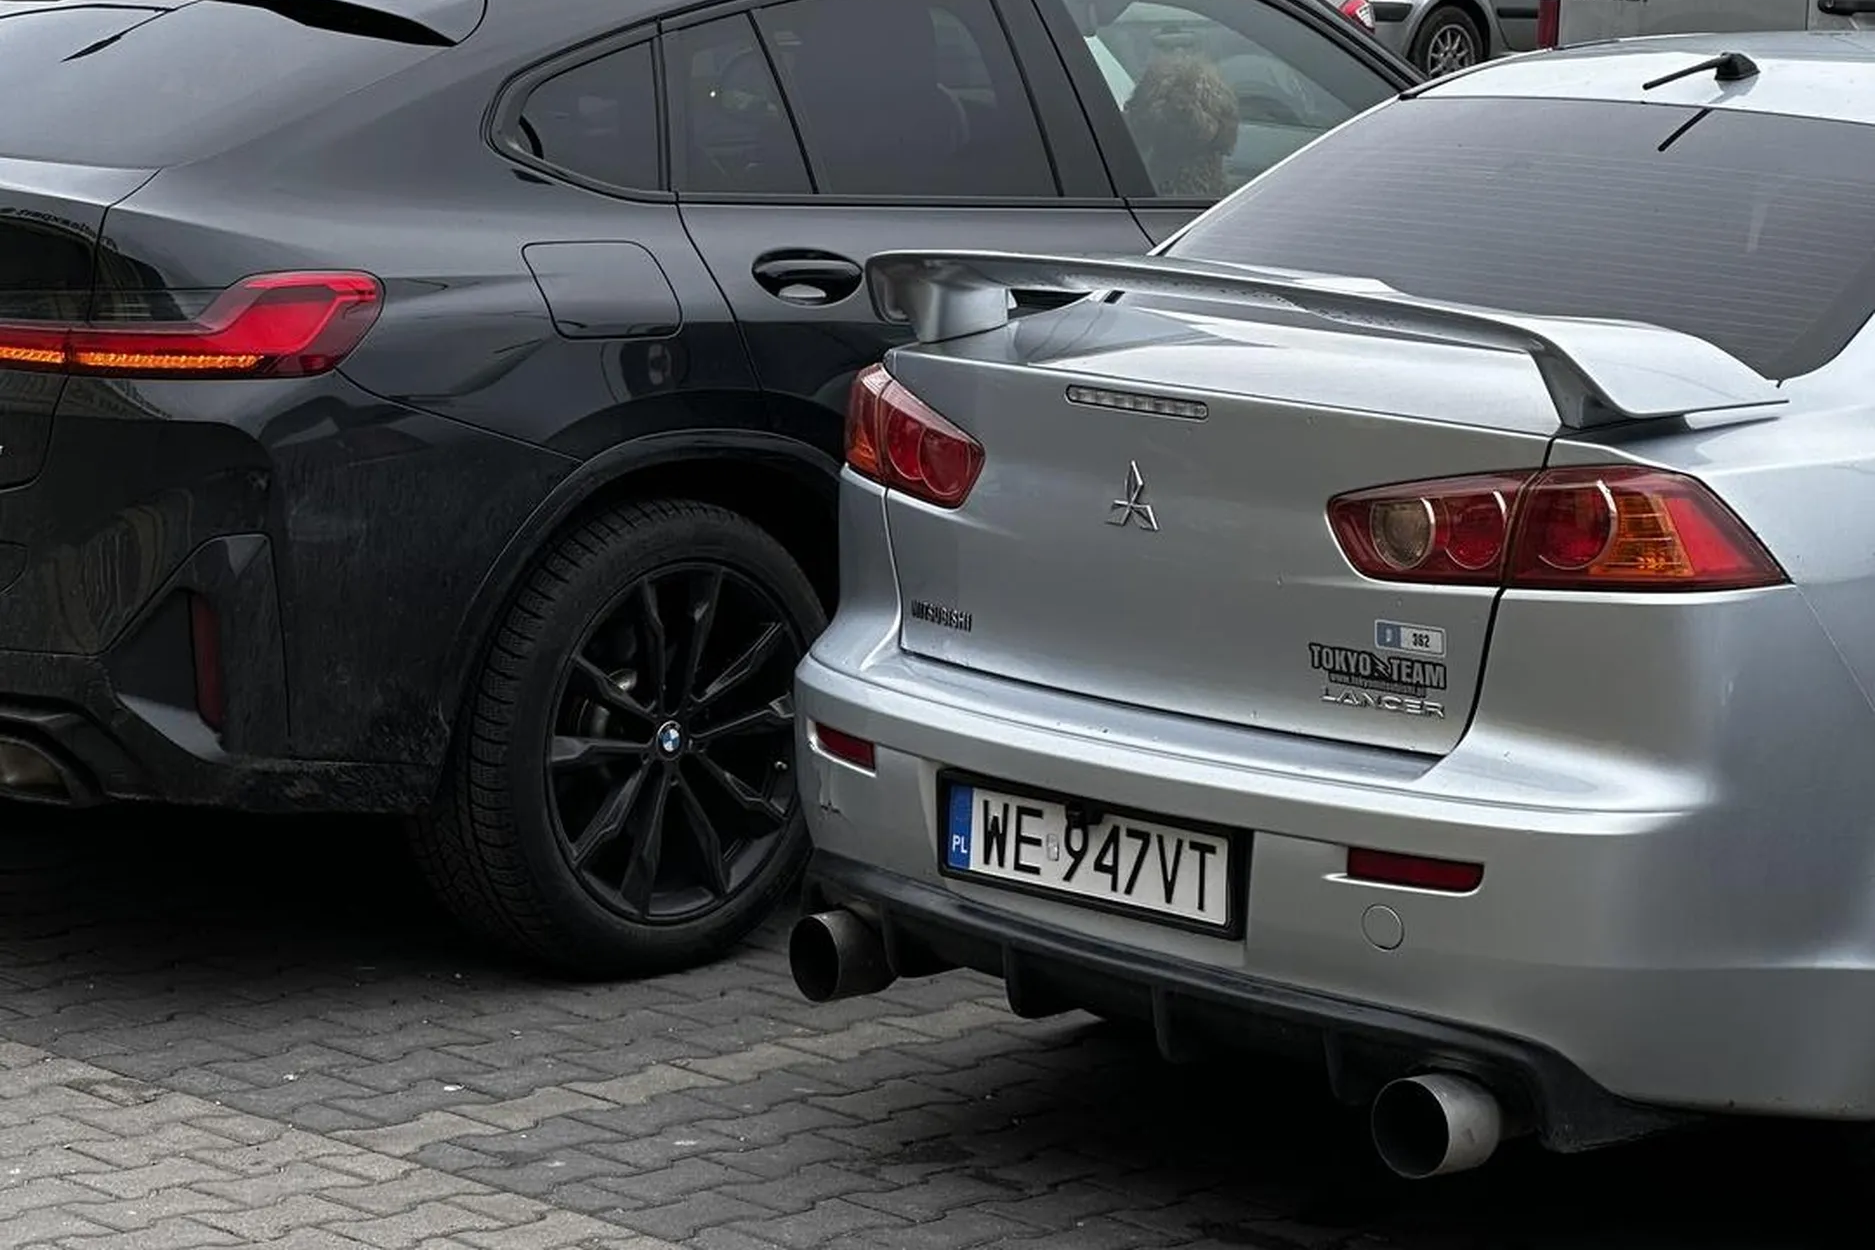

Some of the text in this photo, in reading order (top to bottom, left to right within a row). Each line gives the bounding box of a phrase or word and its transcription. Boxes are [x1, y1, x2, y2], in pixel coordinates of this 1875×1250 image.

[1310, 645, 1372, 676] TOKYO
[1390, 658, 1446, 689] TEAM
[1320, 687, 1446, 718] LANCER
[952, 834, 968, 854] PL
[982, 799, 1218, 912] WE 947VT
